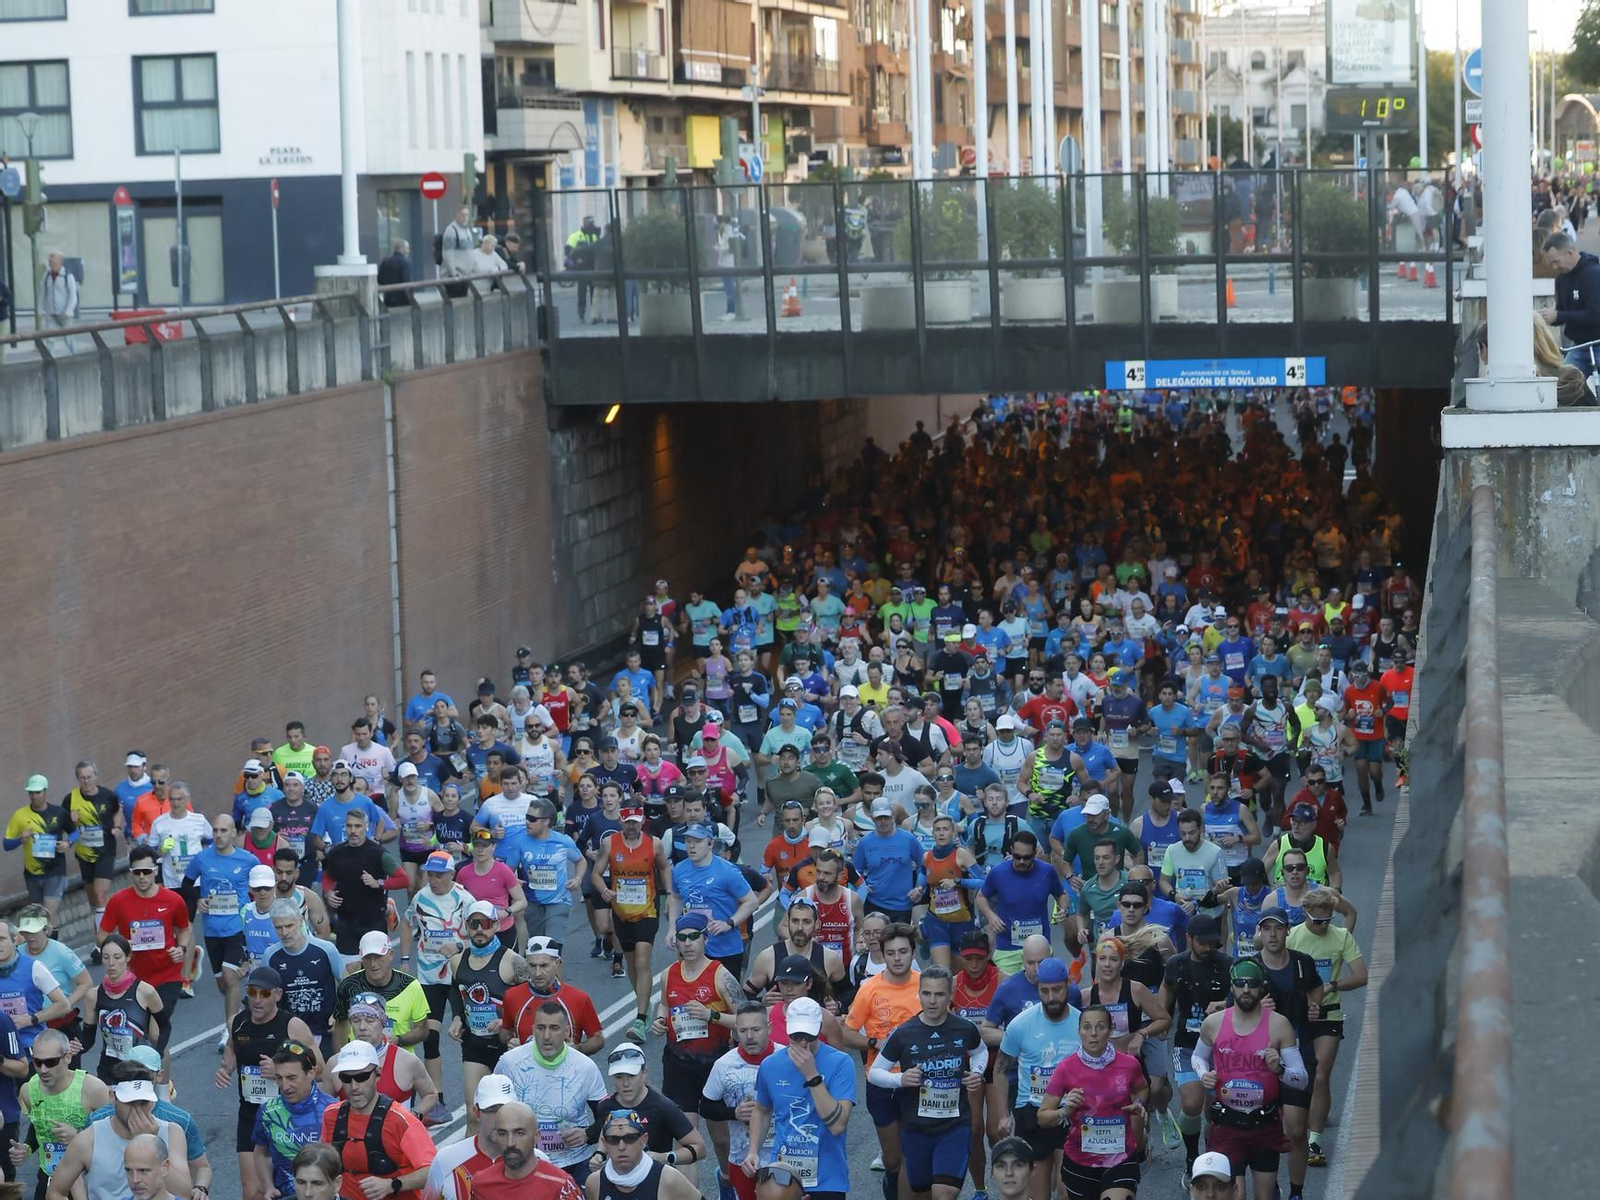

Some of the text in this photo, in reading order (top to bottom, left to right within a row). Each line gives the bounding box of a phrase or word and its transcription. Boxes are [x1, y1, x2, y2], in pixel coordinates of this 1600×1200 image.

[1156, 376, 1277, 388] DELEGACIÓN DE MOVILIDAD
[248, 930, 270, 938] ITALIA
[921, 1057, 962, 1072] MADRID
[1235, 1081, 1259, 1089] ZURICH
[250, 1087, 267, 1095] JGM
[921, 1099, 957, 1109] DANI LLM
[276, 1131, 319, 1143] RUNNE
[543, 1142, 565, 1151] TUNO
